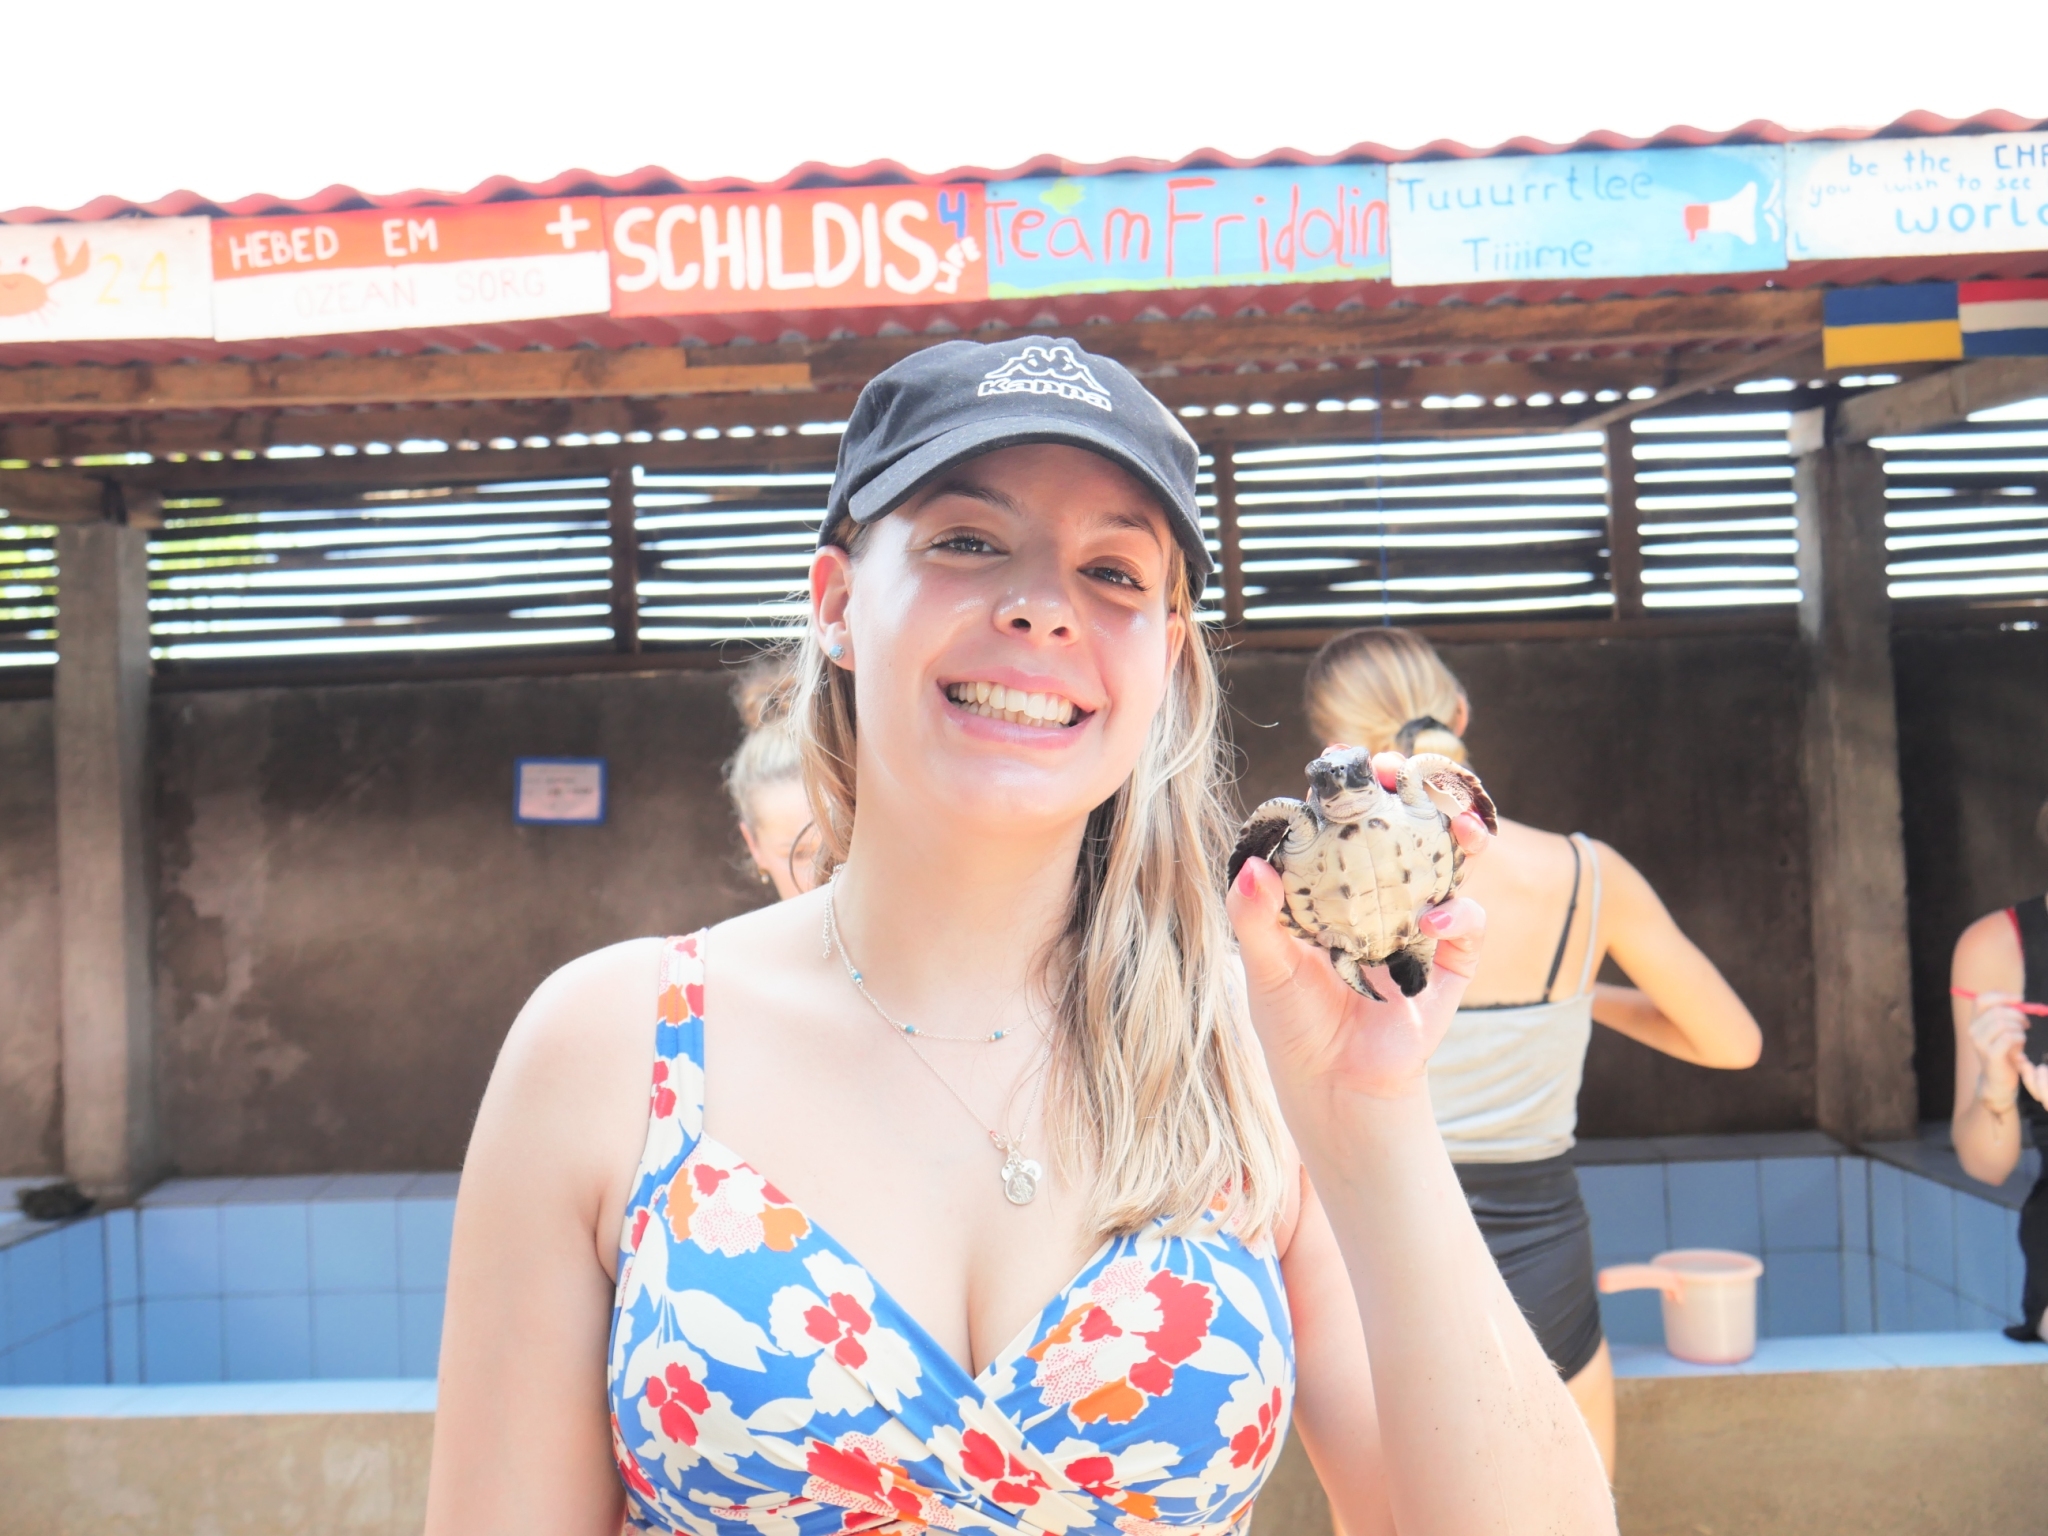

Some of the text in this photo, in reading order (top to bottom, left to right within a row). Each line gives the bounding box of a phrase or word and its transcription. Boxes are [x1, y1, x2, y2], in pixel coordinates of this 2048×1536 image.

[1848, 154, 1878, 176] be
[1903, 149, 1951, 174] the
[1809, 183, 1851, 208] you
[1955, 173, 1981, 191] to
[1995, 176, 2031, 191] see
[229, 218, 439, 271] HEBED EM
[613, 199, 940, 294] SCHILDIS
[939, 191, 966, 238] 4
[294, 267, 547, 318] OZEAN SORG
[977, 378, 1113, 412] Kappa
